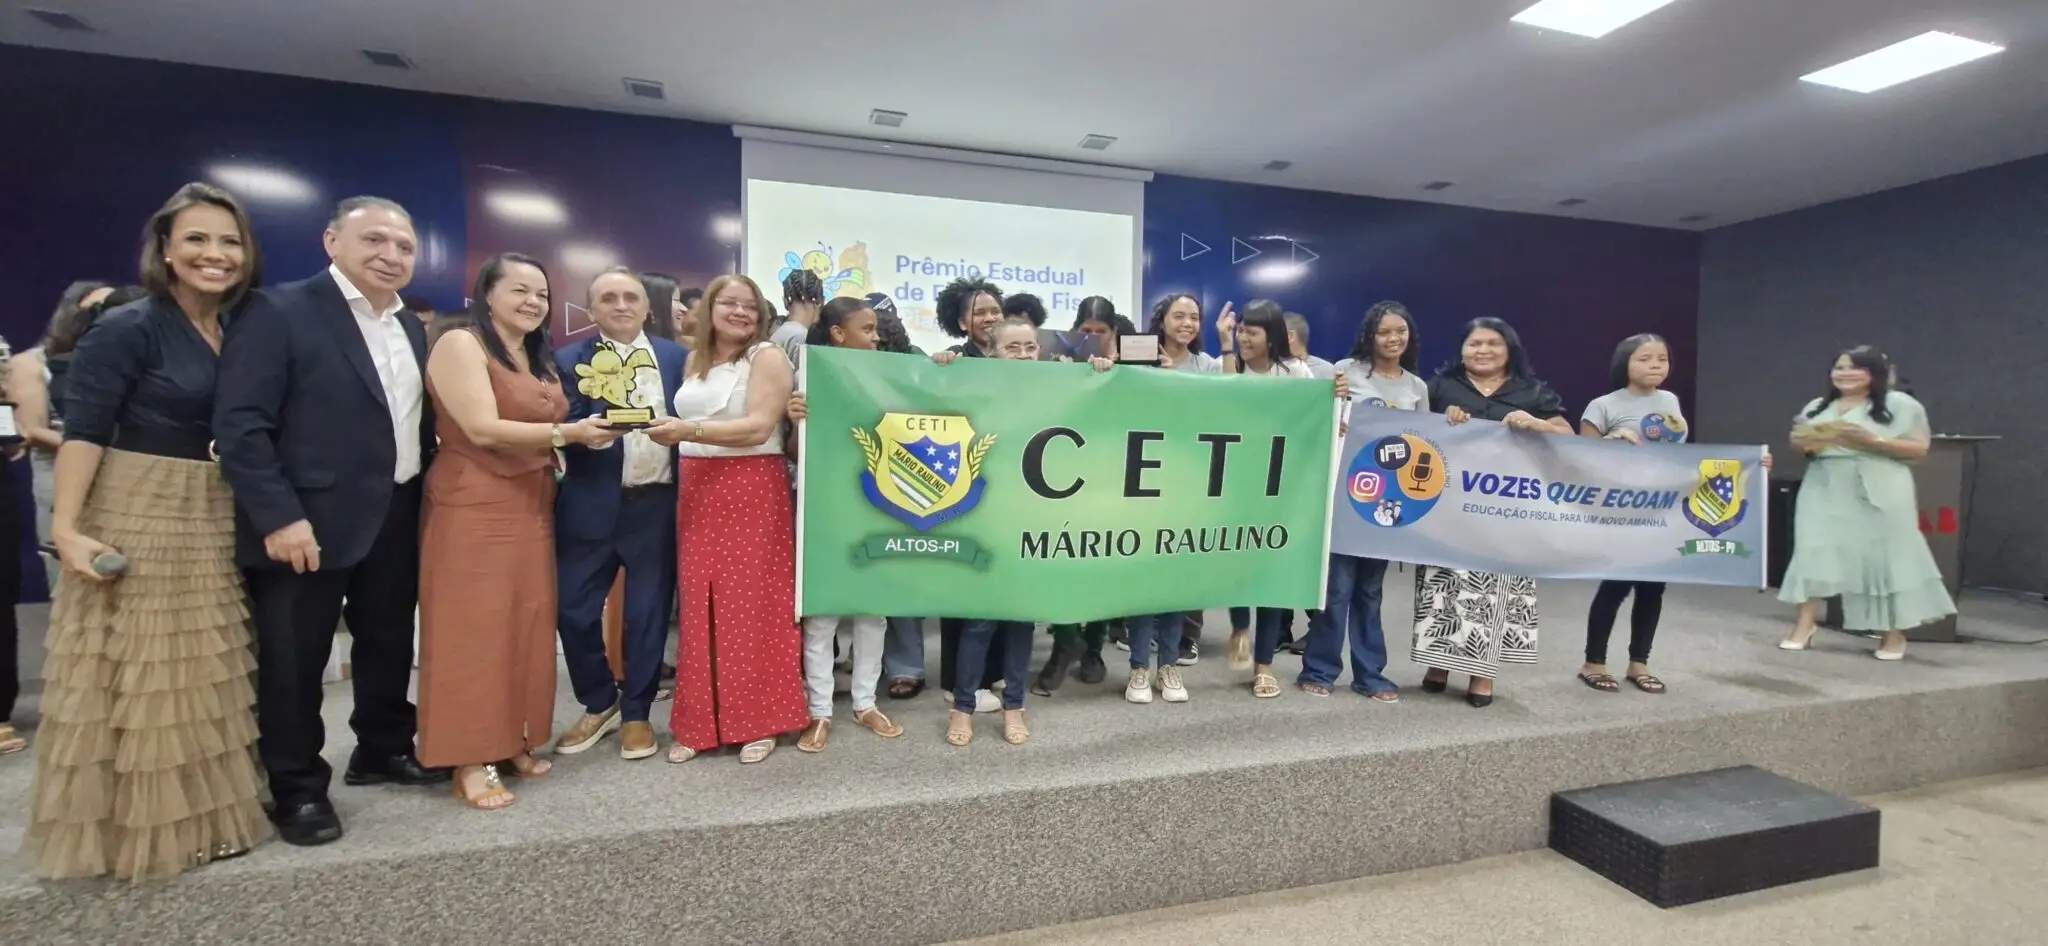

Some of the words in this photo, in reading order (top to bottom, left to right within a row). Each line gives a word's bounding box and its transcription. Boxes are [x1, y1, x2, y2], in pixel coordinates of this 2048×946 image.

[896, 254, 982, 279] Prêmio
[988, 262, 1084, 286] Estadual
[894, 281, 924, 301] de
[905, 417, 947, 432] CETI
[893, 448, 917, 471] MÁRIO
[915, 465, 946, 493] RAULINO
[1021, 426, 1286, 499] CETI
[1461, 470, 1541, 500] VOZES
[1547, 482, 1601, 505] QUE
[1601, 489, 1679, 509] ECOAM
[1529, 510, 1557, 522] FISCAL
[1560, 513, 1582, 523] PARA
[1583, 514, 1599, 524] UM
[1599, 516, 1626, 526] NOVO
[885, 538, 960, 553] ALTOS-PI
[1020, 521, 1141, 559] MÁRIO
[1154, 524, 1289, 555] RAULINO
